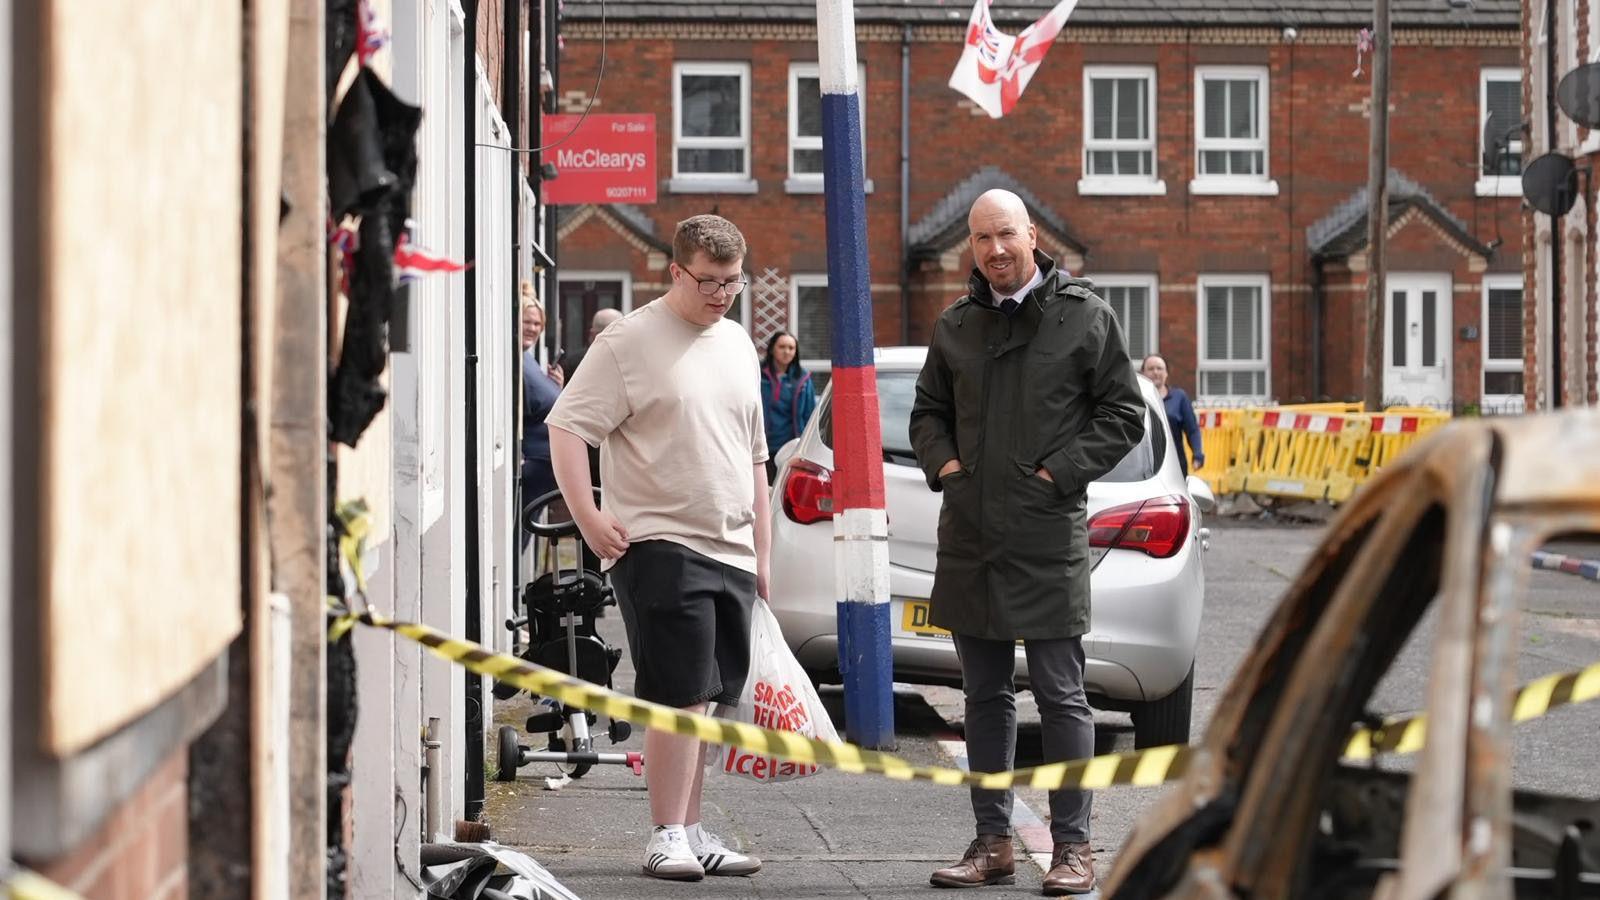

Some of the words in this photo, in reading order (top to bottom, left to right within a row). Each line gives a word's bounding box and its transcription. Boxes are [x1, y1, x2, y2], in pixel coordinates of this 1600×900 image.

[612, 122, 625, 133] For
[627, 122, 645, 133] Sale
[557, 148, 645, 172] McClearys
